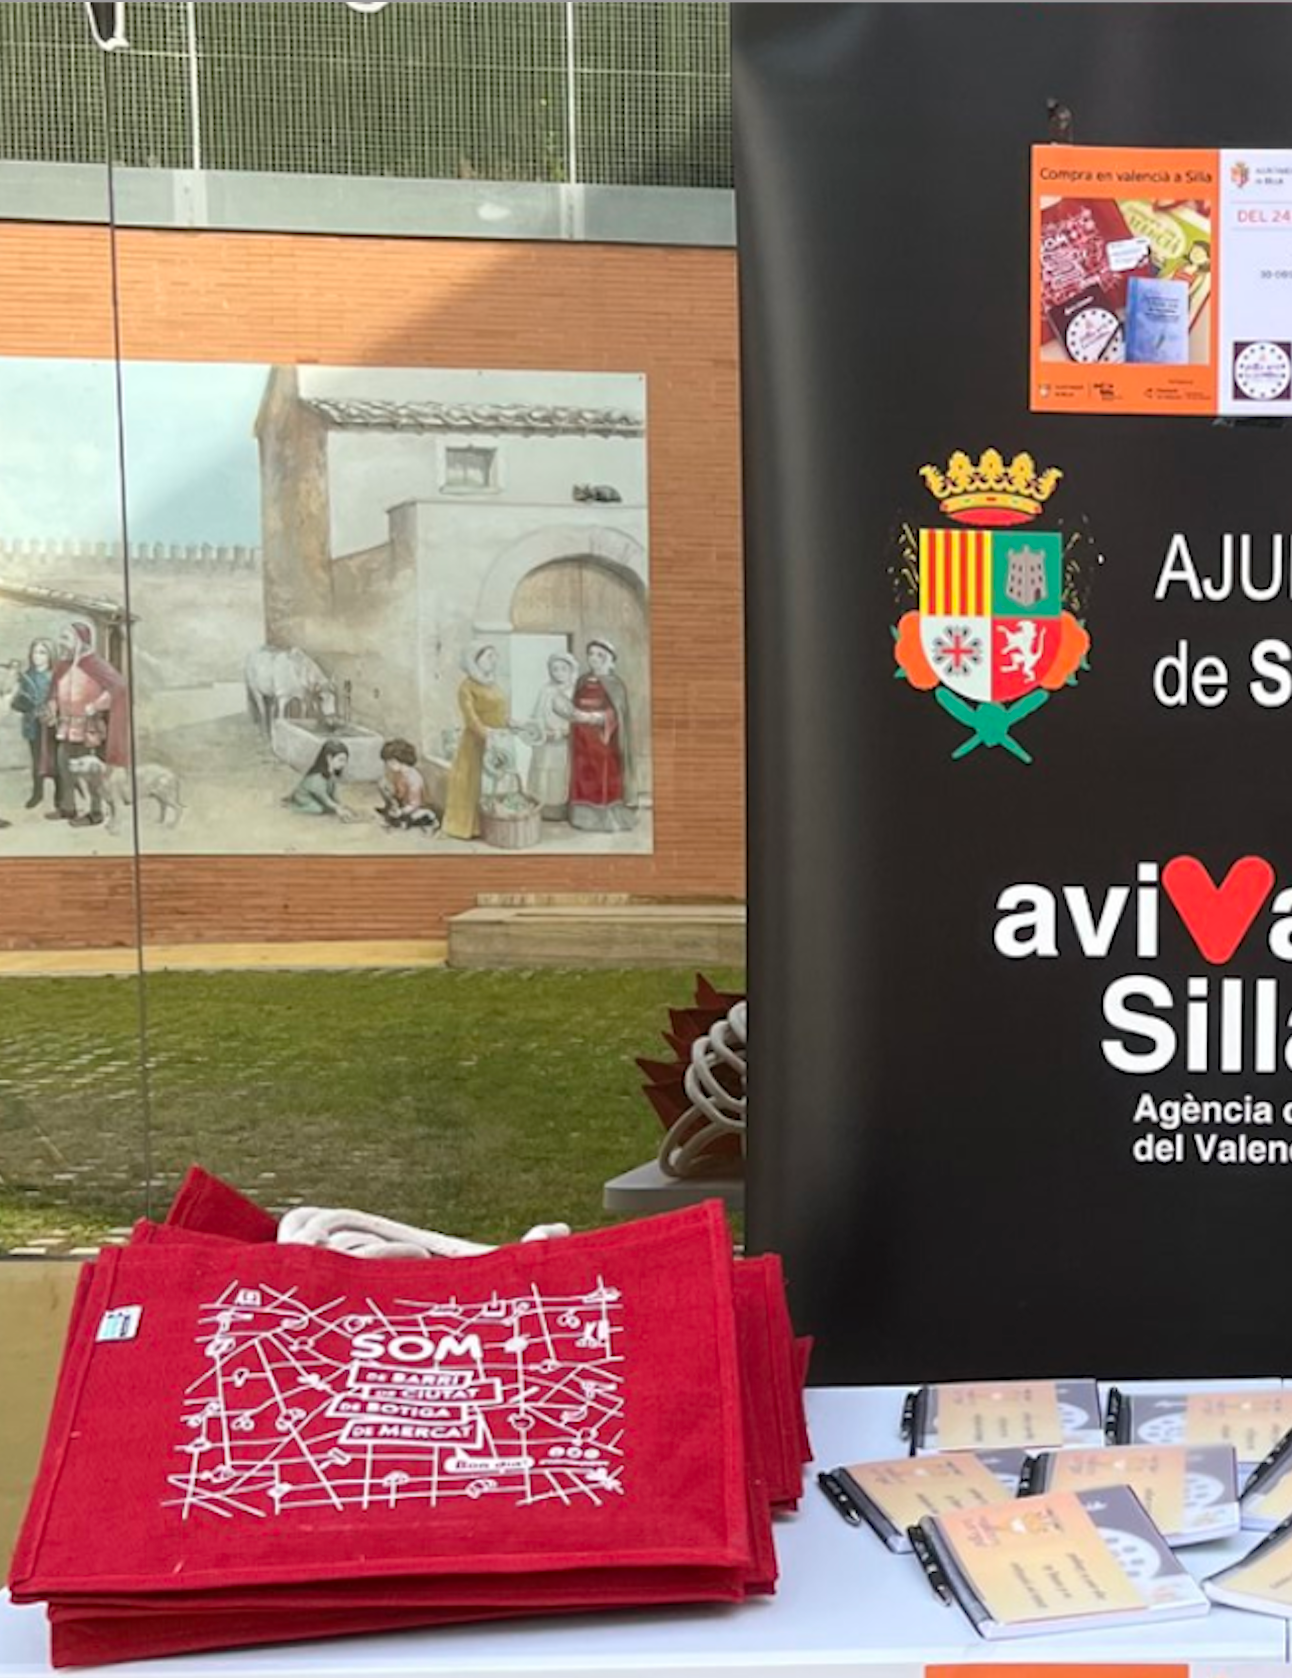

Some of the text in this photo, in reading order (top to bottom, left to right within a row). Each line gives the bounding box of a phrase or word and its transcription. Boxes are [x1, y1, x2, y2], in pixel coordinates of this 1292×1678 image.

[1039, 167, 1213, 184] Compra en valencià a Silla
[1237, 209, 1267, 224] DEL
[1271, 209, 1291, 223] 24
[1153, 638, 1229, 708] de
[1132, 1093, 1274, 1130] Agència
[1132, 1133, 1185, 1163] del
[349, 1333, 484, 1362] SOM
[365, 1371, 461, 1388] DE BARRI
[401, 1387, 480, 1400] CIUTAT
[338, 1400, 452, 1419] DE BOTIGA
[351, 1424, 475, 1440] DE MERCAT
